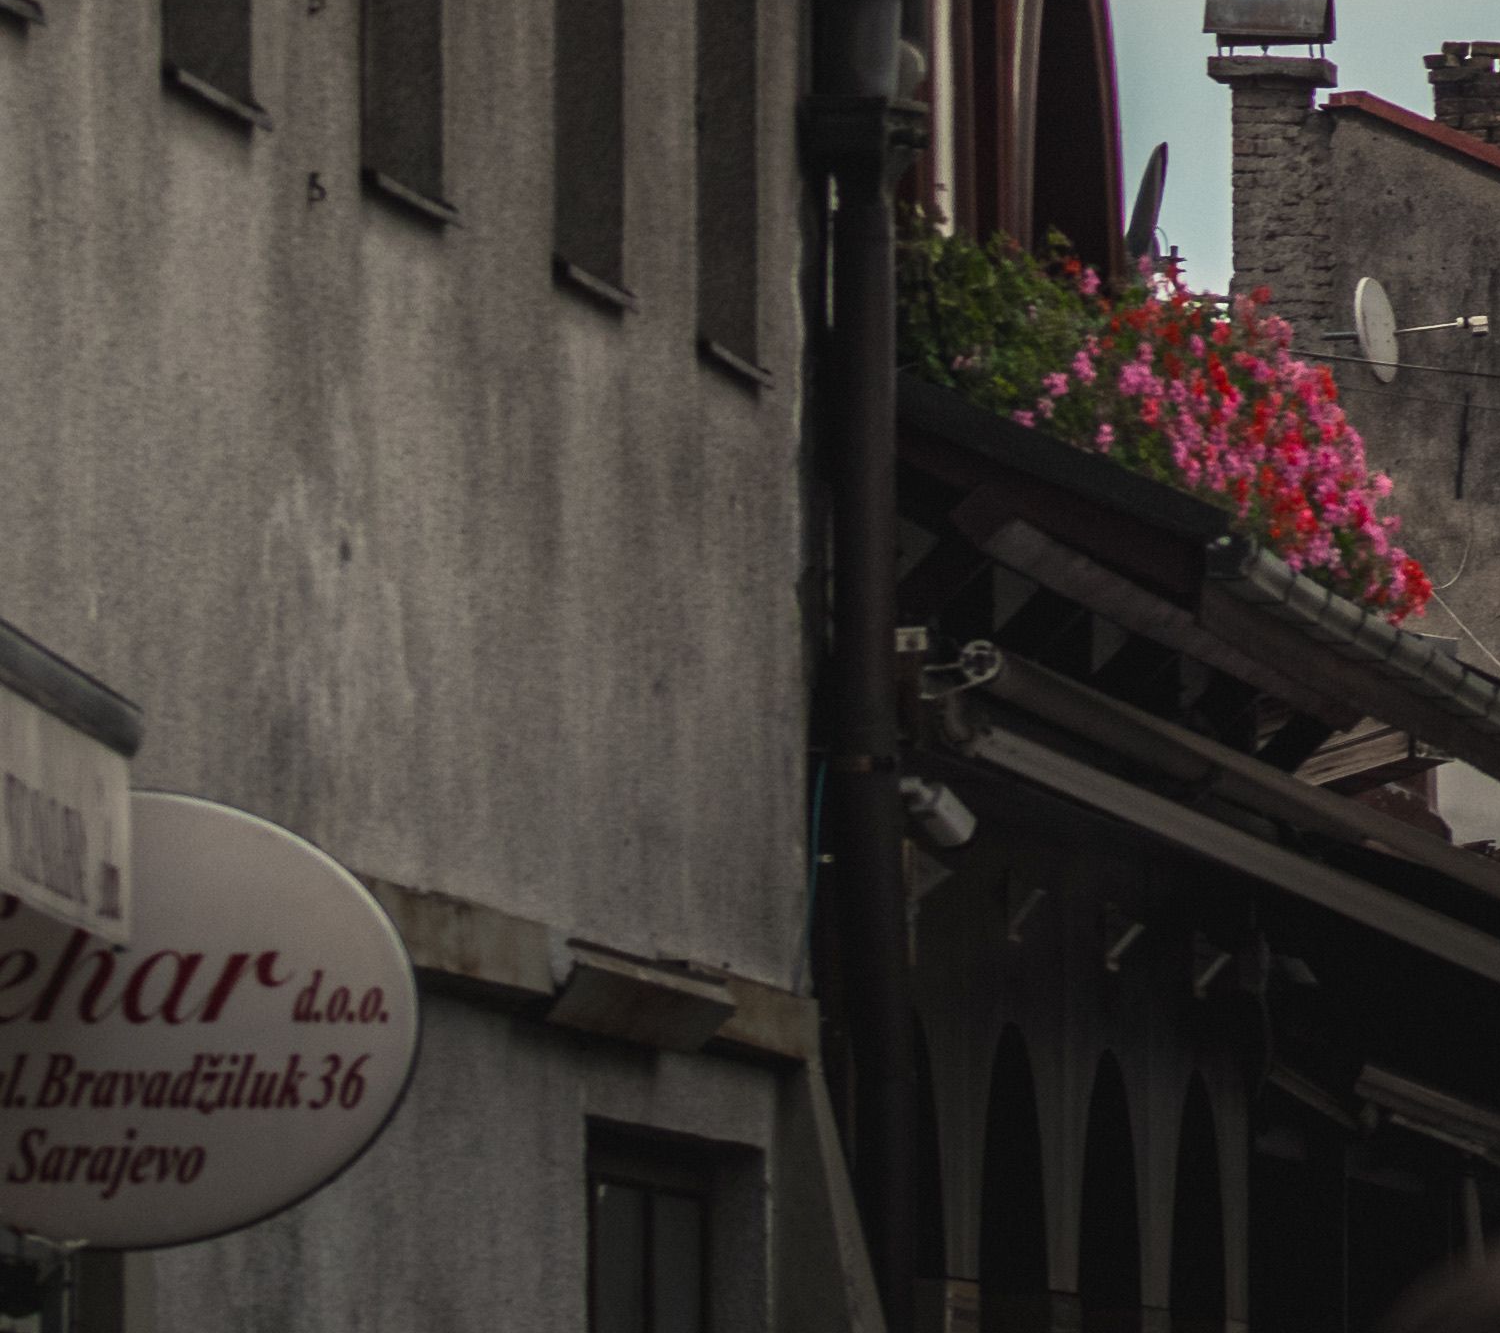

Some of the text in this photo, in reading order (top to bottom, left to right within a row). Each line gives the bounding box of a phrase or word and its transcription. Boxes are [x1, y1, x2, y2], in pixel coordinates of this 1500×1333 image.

[0, 893, 390, 1025] ehar d.o.o.
[0, 1052, 371, 1114] l. Bravadžiluk 36
[7, 1126, 208, 1200] Sarajevo
